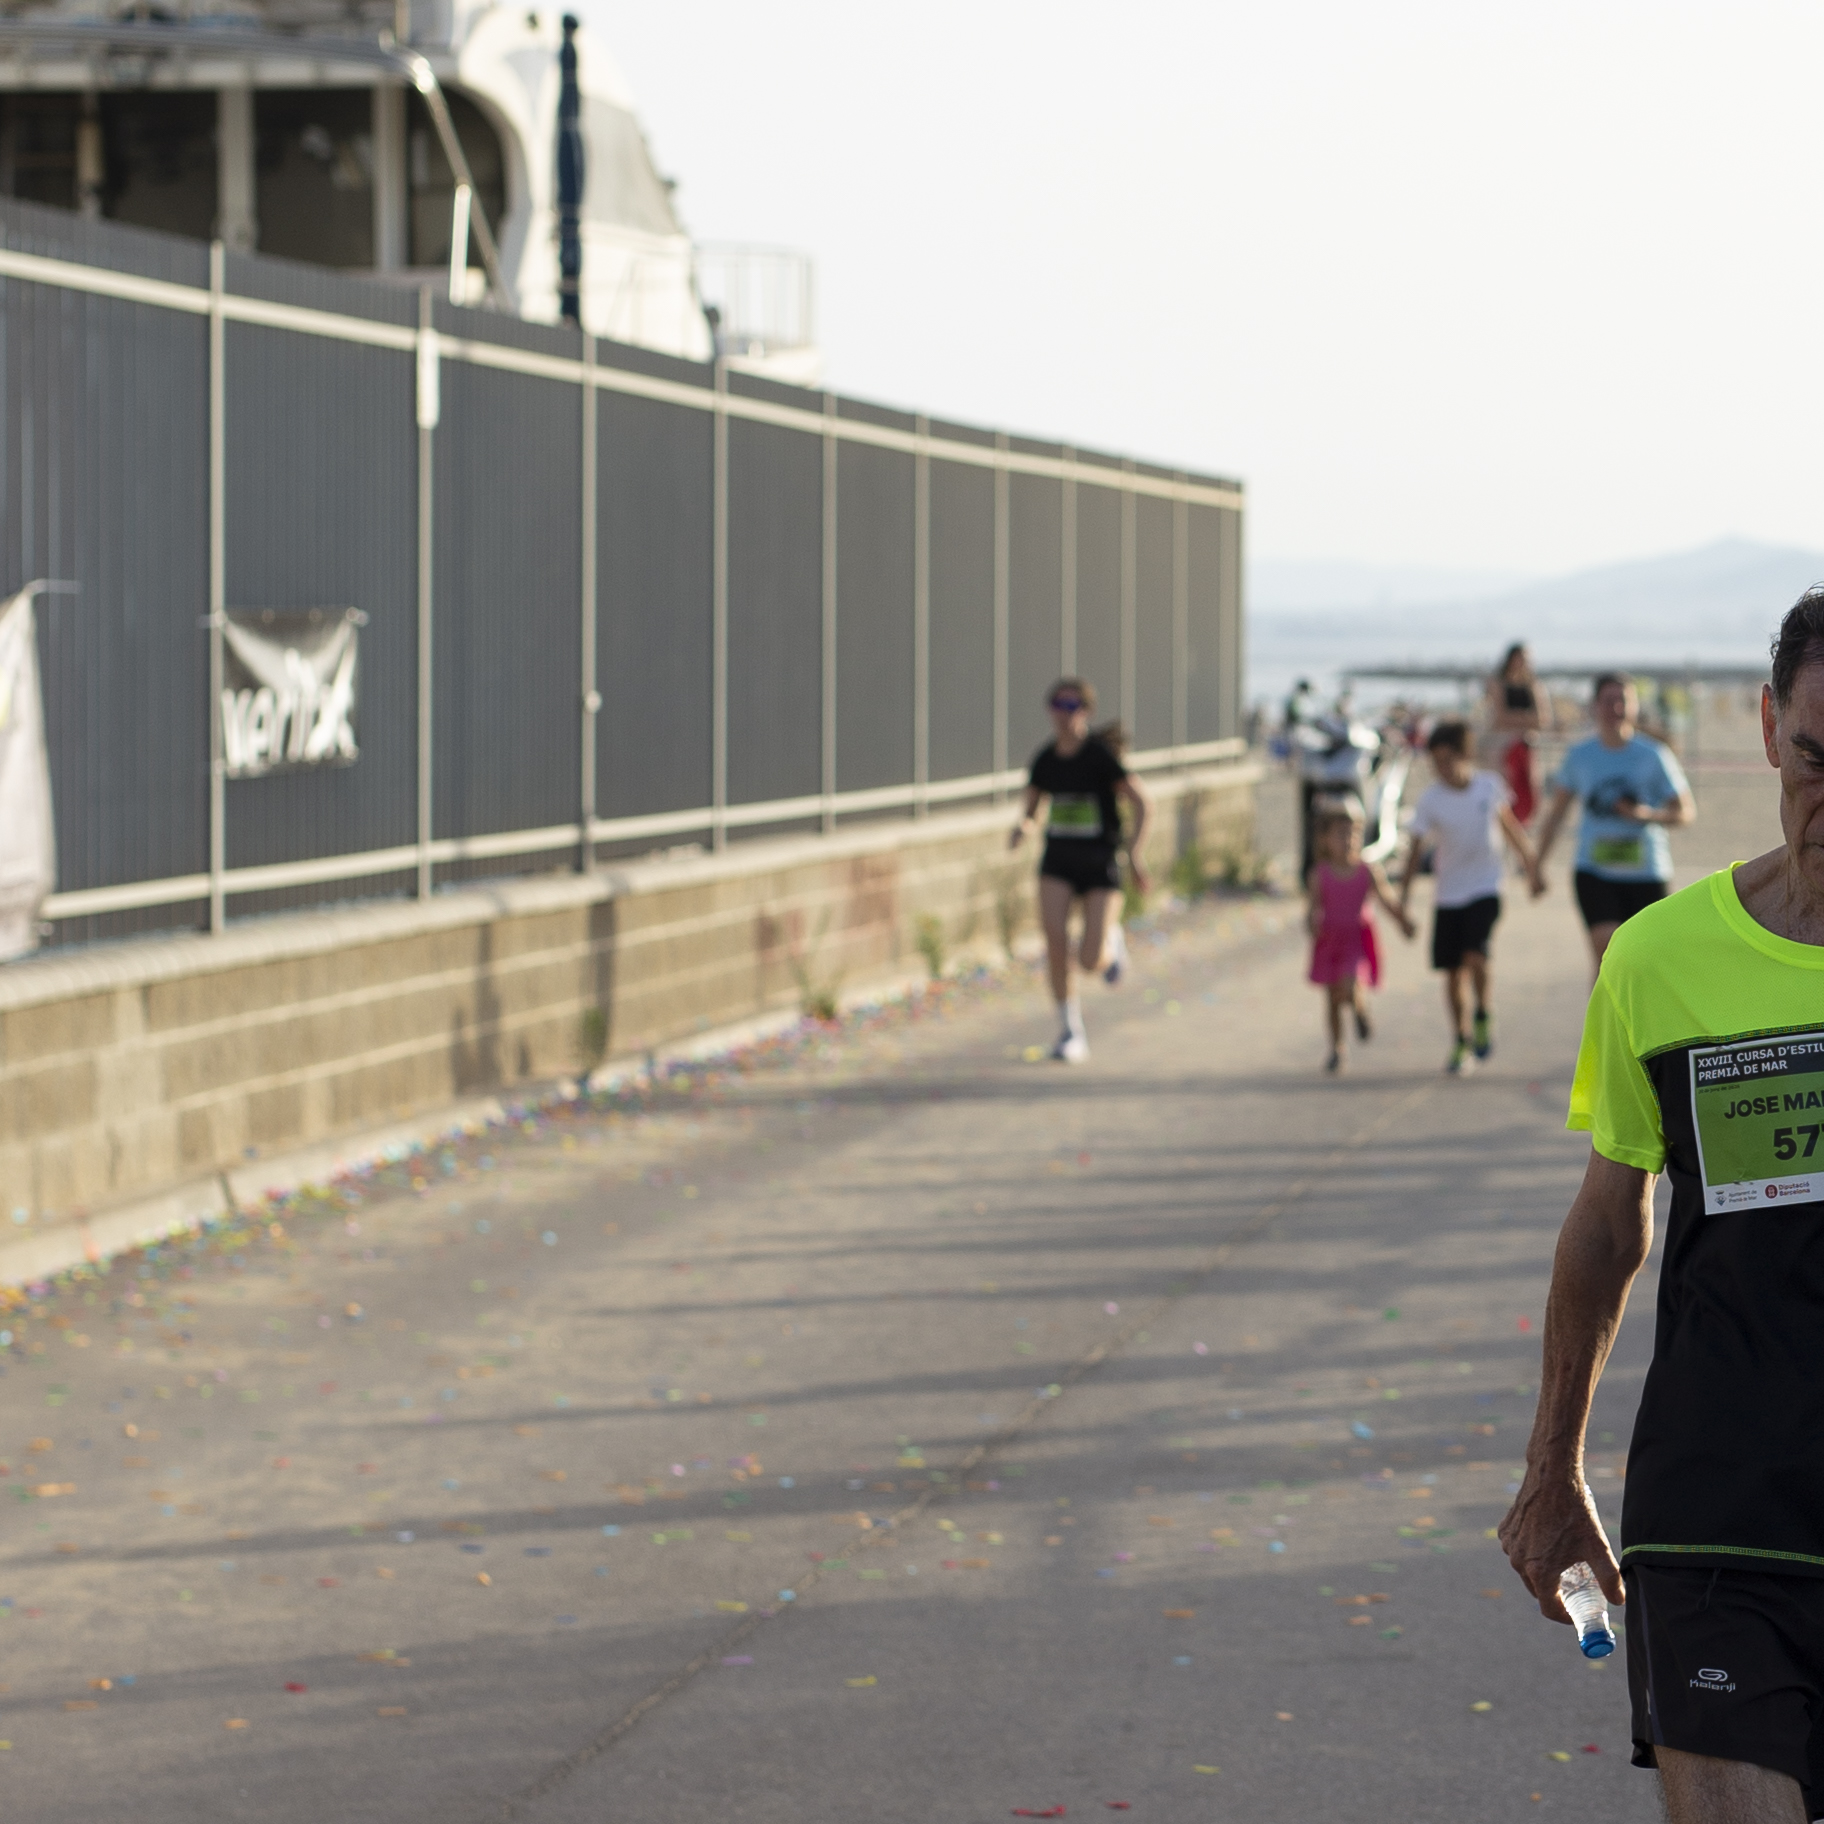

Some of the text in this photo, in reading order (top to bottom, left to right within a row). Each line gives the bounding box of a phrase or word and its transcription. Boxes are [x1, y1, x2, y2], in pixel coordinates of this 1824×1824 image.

[1697, 1054, 1733, 1069] XXVIII
[1736, 1050, 1775, 1064] CURSA
[1698, 1059, 1788, 1082] PREMIÀ DE MAR
[1723, 1095, 1780, 1120] JOSE
[1689, 1678, 1737, 1693] Kalenji
